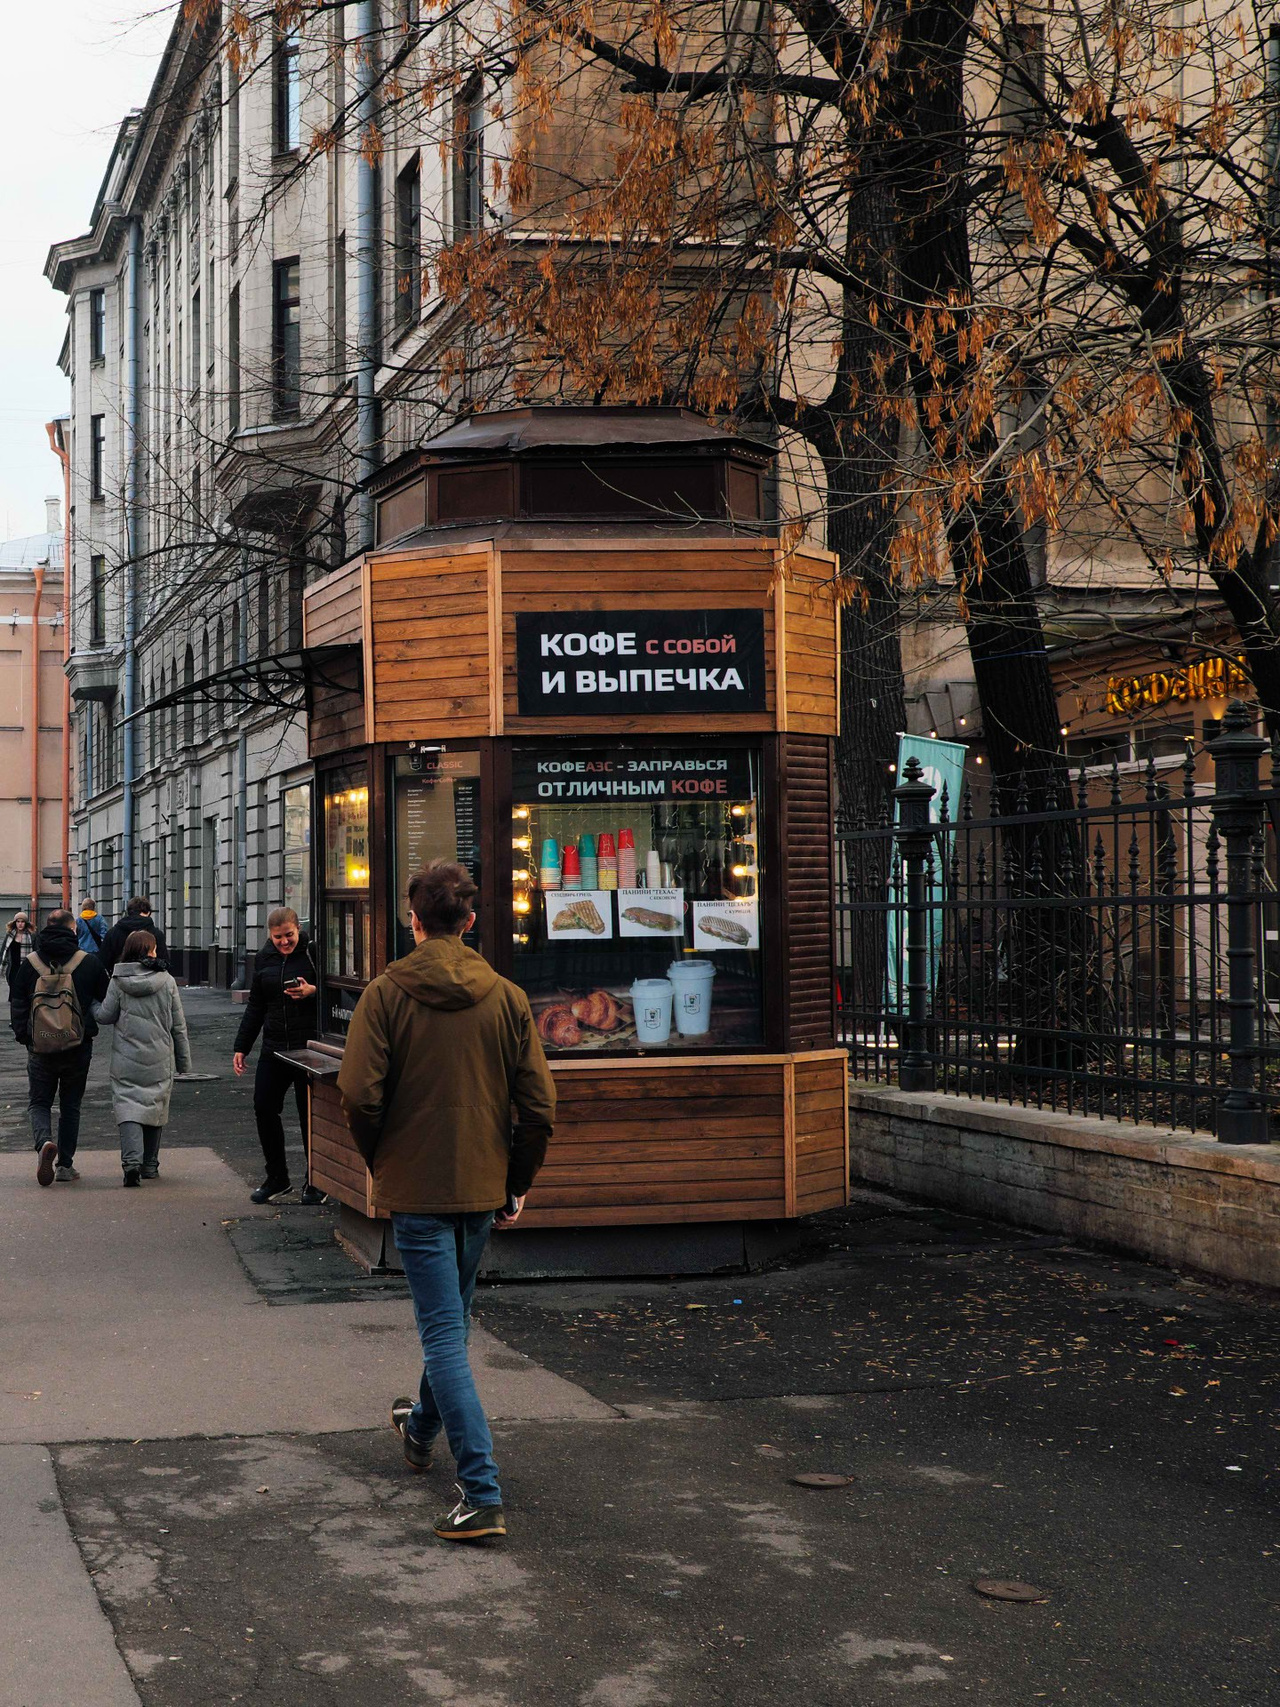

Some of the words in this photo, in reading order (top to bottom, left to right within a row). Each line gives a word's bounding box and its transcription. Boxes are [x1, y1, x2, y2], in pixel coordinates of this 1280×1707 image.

[540, 631, 637, 657] КОФЕ
[645, 639, 659, 655] С
[663, 633, 736, 655] СОБОЙ
[541, 670, 566, 694] И
[575, 667, 745, 694] ВЫПЕЧКА
[426, 760, 464, 770] CLASSIC
[536, 761, 614, 773] КОФЕАЗС
[627, 759, 728, 772] ЗАПРАВЬСЯ
[537, 780, 666, 797] ОТЛИЧНЫМ
[671, 778, 728, 794] КОФЕ
